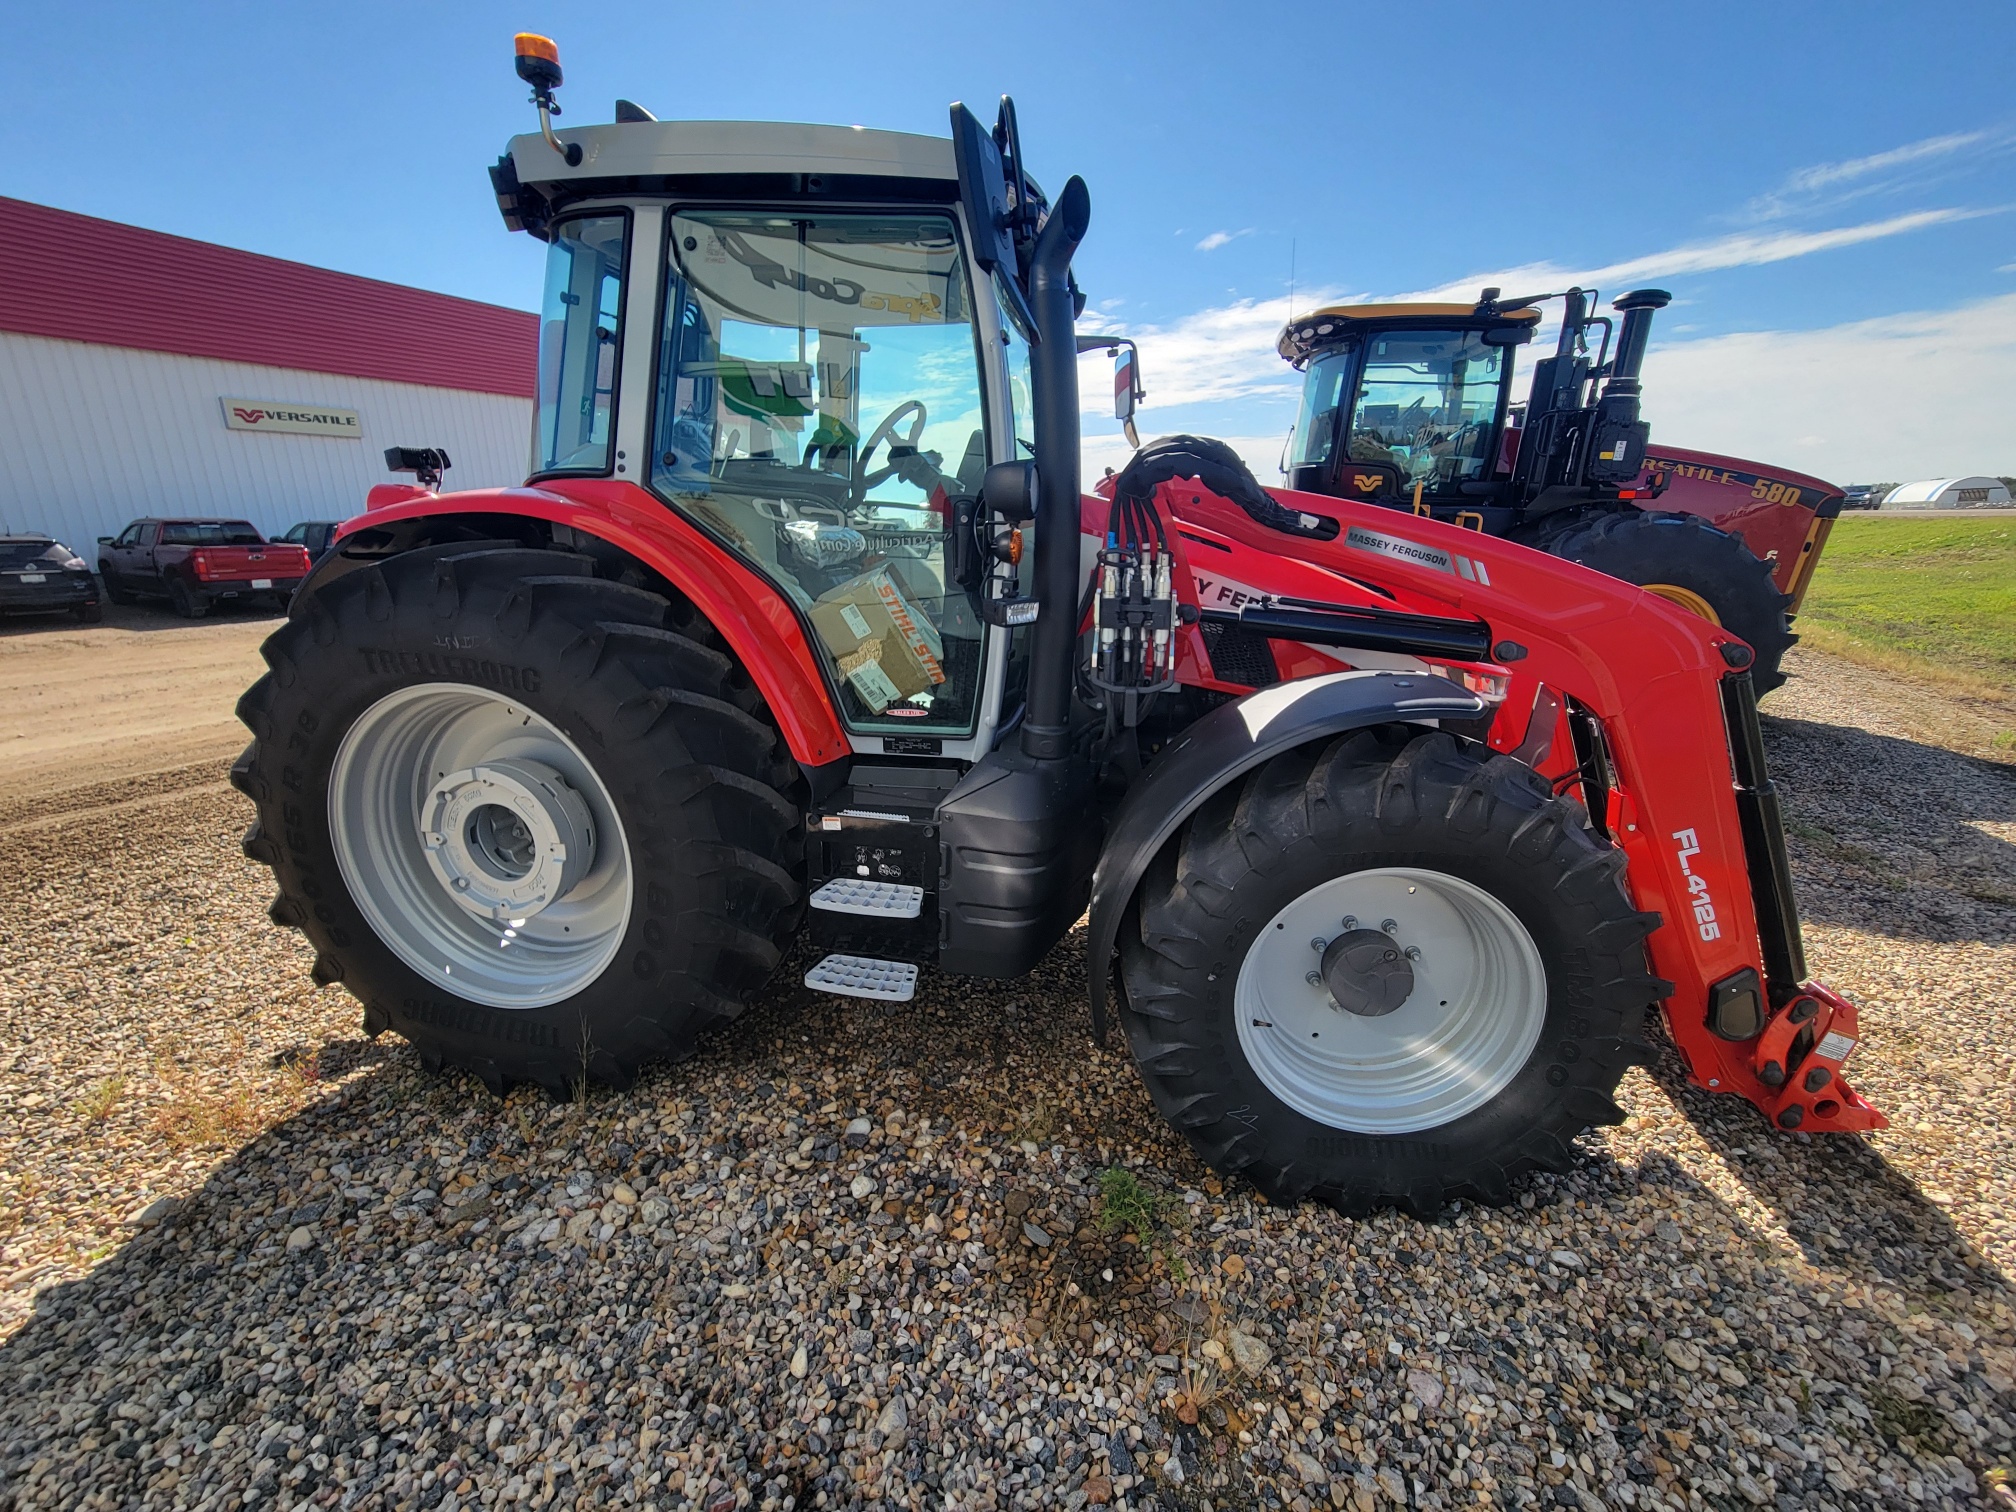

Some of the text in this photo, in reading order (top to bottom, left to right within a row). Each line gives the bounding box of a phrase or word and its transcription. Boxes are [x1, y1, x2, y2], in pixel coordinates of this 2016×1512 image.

[264, 410, 357, 426] VERSATILE
[1750, 478, 1801, 508] 580
[1348, 532, 1447, 567] MASSEY FERGUSON
[877, 584, 917, 640] STIHL
[1672, 827, 1721, 942] FL.4125
[1545, 947, 1595, 1088] TM800
